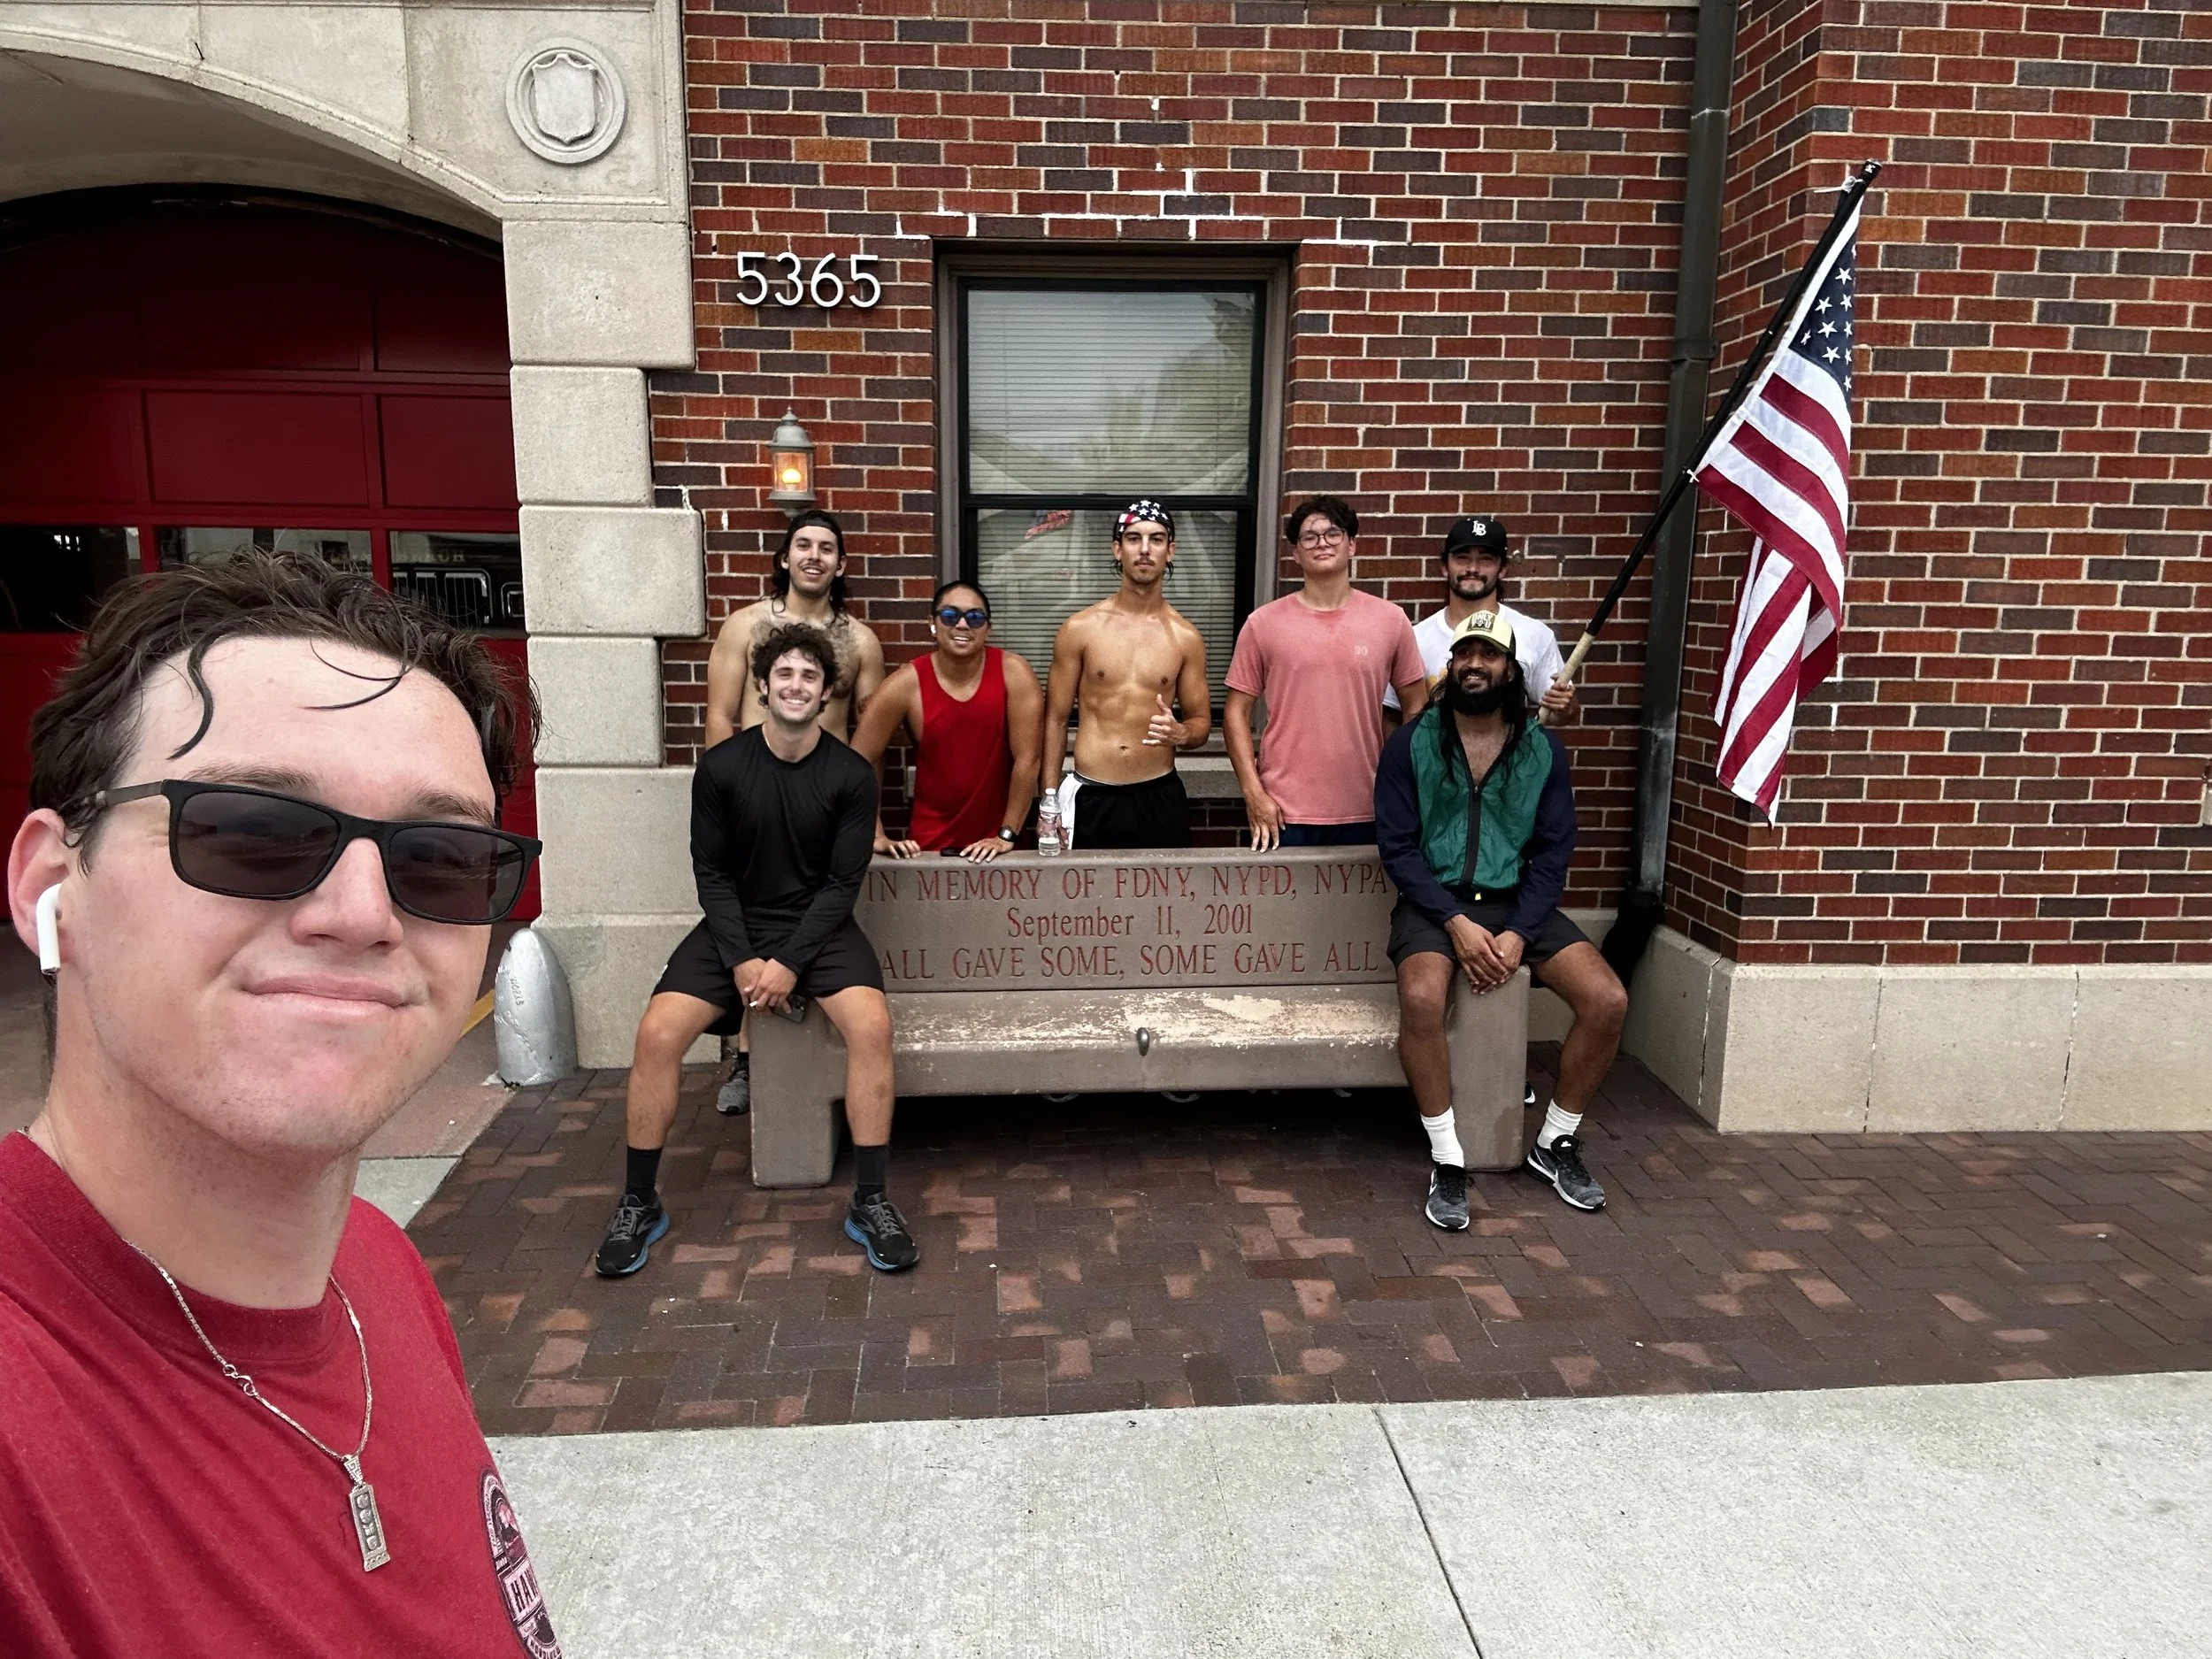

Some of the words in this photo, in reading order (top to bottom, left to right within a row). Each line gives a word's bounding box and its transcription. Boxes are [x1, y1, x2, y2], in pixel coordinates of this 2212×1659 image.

[736, 251, 880, 307] 5365
[1471, 520, 1486, 536] LB
[867, 871, 898, 902] IN
[917, 869, 1044, 901] MEMORY
[1062, 868, 1096, 899] OF
[1114, 866, 1194, 901] FDNY,
[1210, 864, 1297, 900] NYPD,
[1314, 863, 1389, 895] NYPA
[1007, 905, 1134, 944] September
[1156, 905, 1180, 939] 11,
[1203, 903, 1252, 934] 2001
[883, 949, 933, 979] ALL
[953, 948, 1025, 979] GAVE
[1041, 945, 1124, 980] SOME,
[1140, 944, 1217, 975] SOME
[1234, 943, 1305, 973] GAVE
[1324, 941, 1379, 972] ALL
